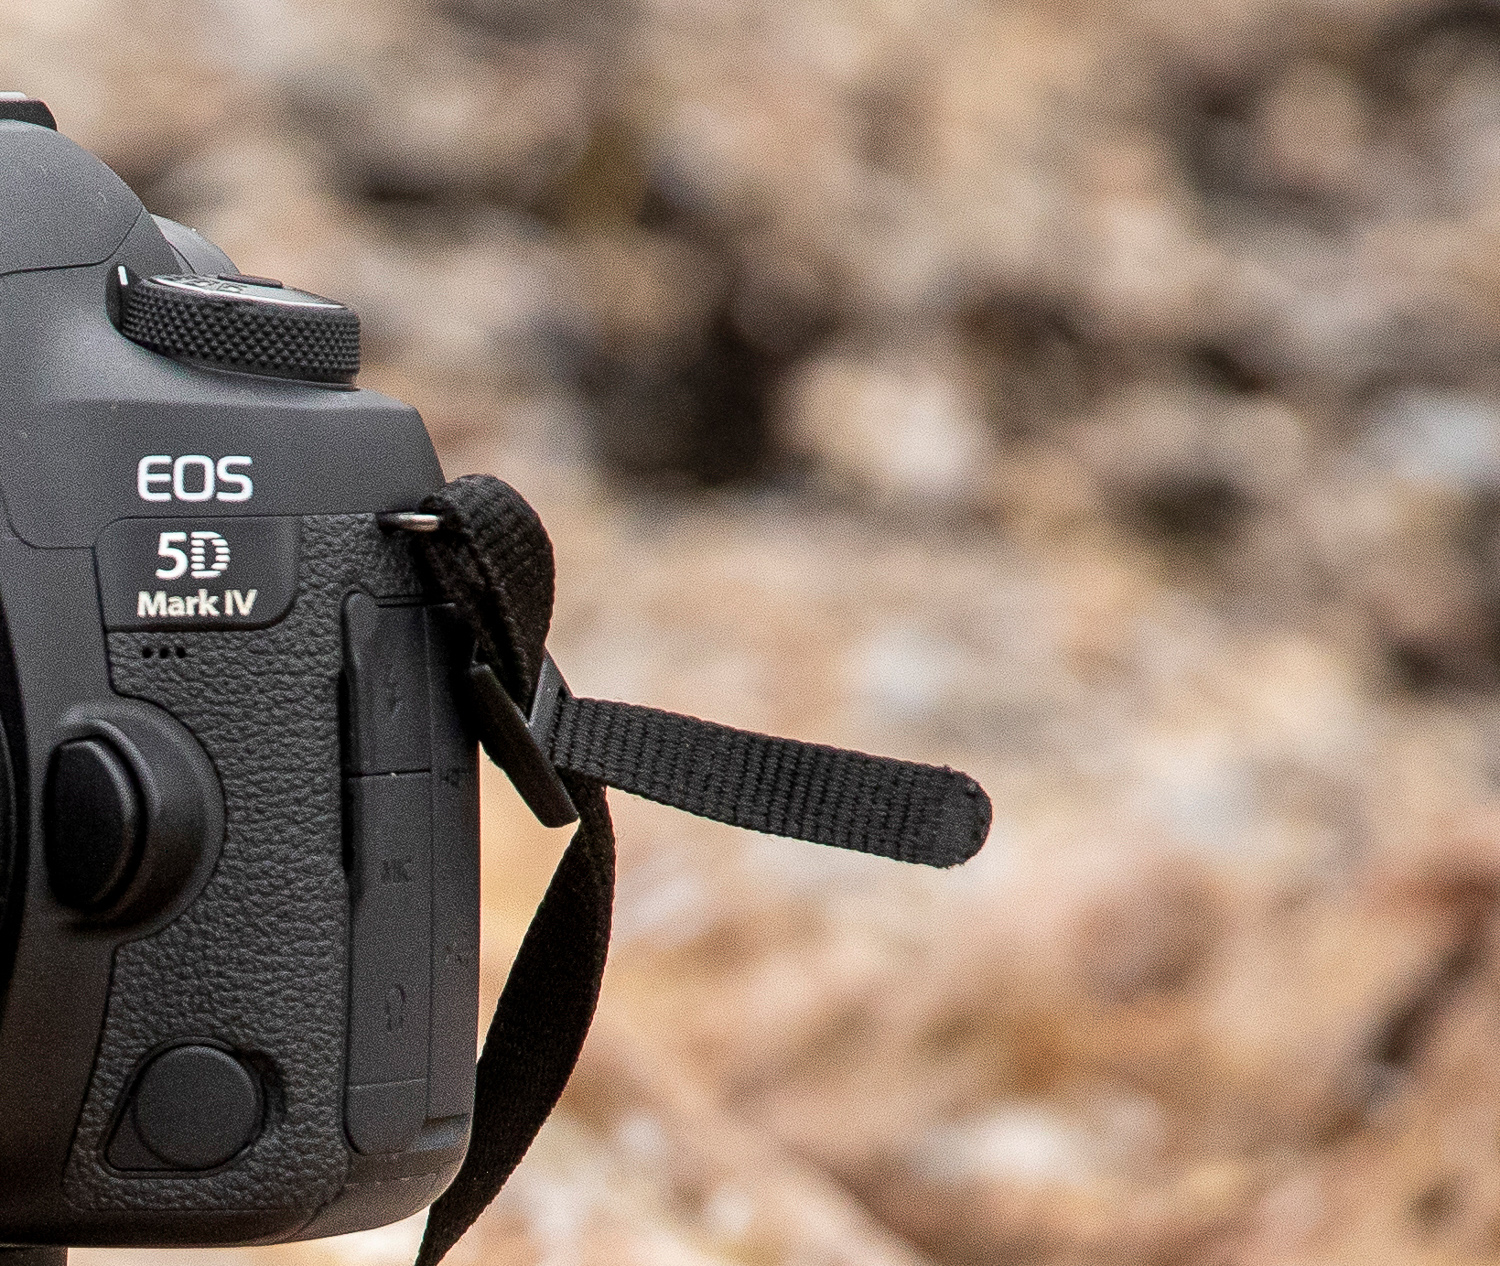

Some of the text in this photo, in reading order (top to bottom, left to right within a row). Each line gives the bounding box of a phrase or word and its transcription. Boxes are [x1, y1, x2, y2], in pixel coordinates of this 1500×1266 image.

[137, 455, 254, 502] EOS
[155, 531, 231, 580] 5D
[137, 588, 258, 618] Mark IV
